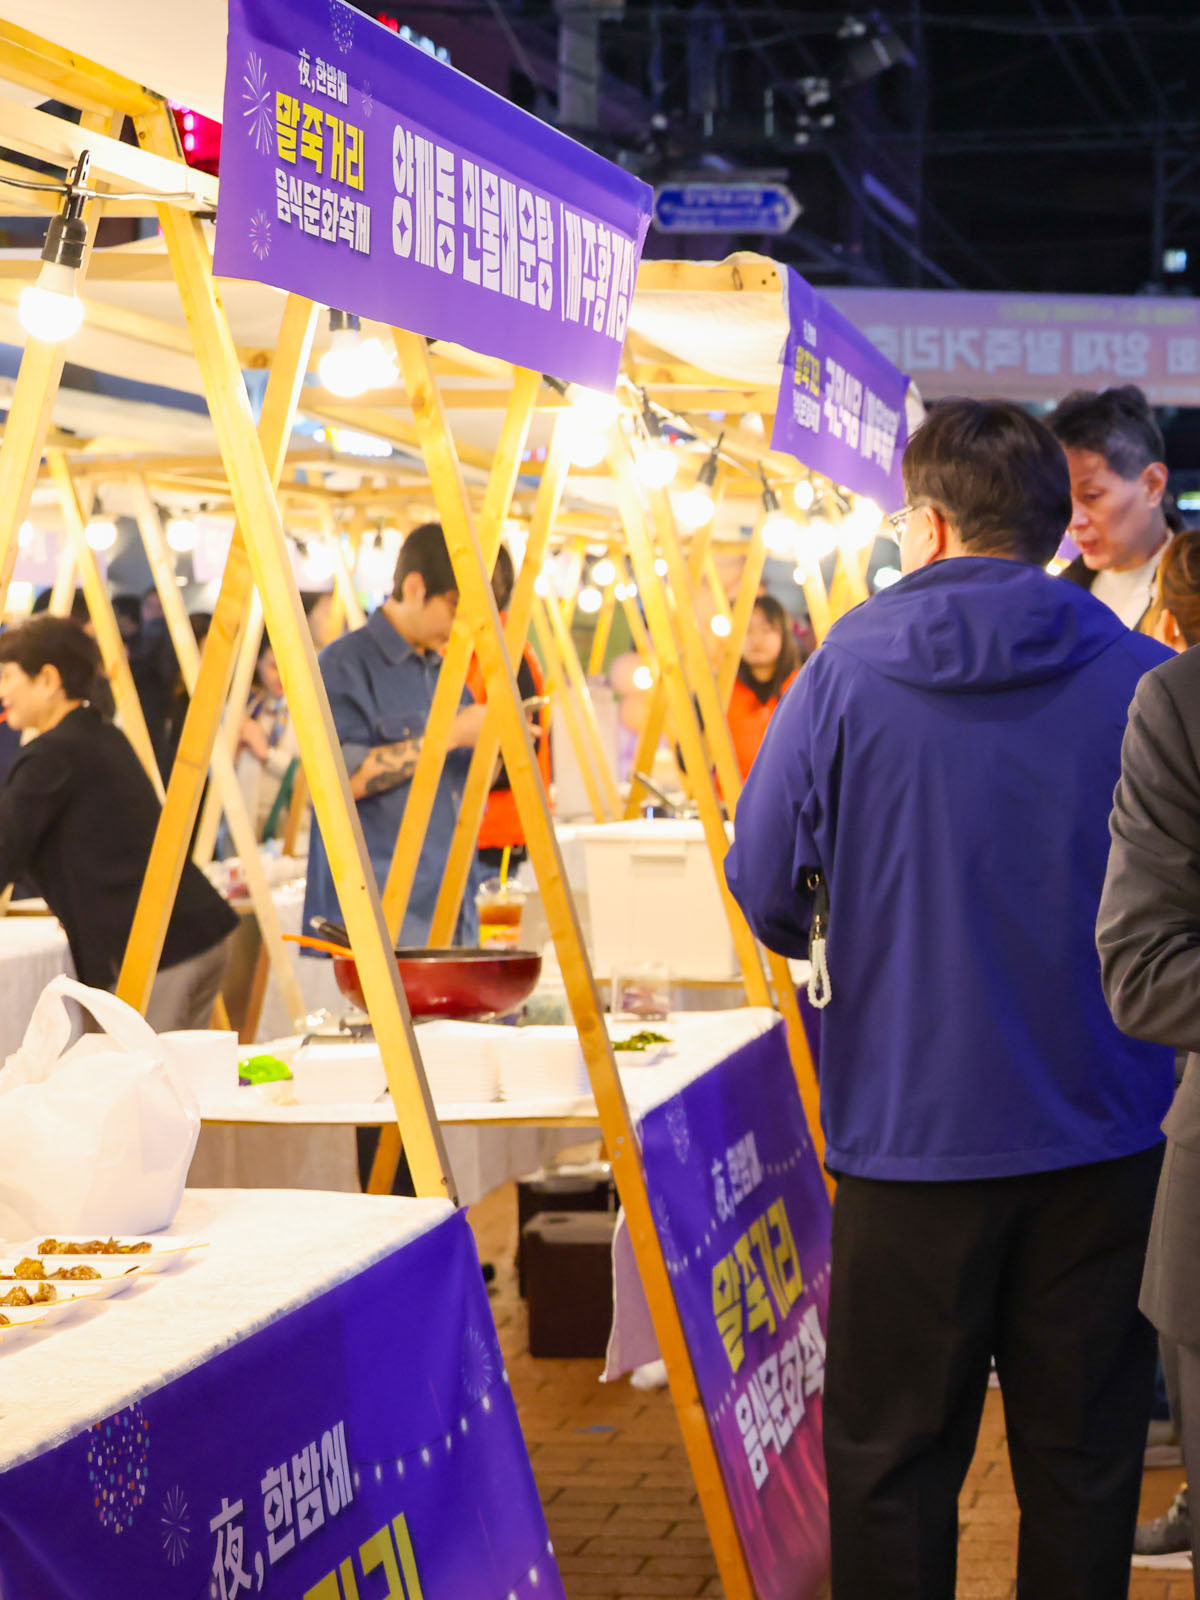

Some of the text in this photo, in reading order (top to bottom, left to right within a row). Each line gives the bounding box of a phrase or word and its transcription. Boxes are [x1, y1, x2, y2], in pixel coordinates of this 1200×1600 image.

[275, 90, 365, 192] 말죽거리
[275, 167, 371, 256] 음식문화축제
[391, 124, 455, 275] 양재동
[461, 158, 554, 312] 민물매운탕
[711, 1195, 803, 1374] 말죽거리
